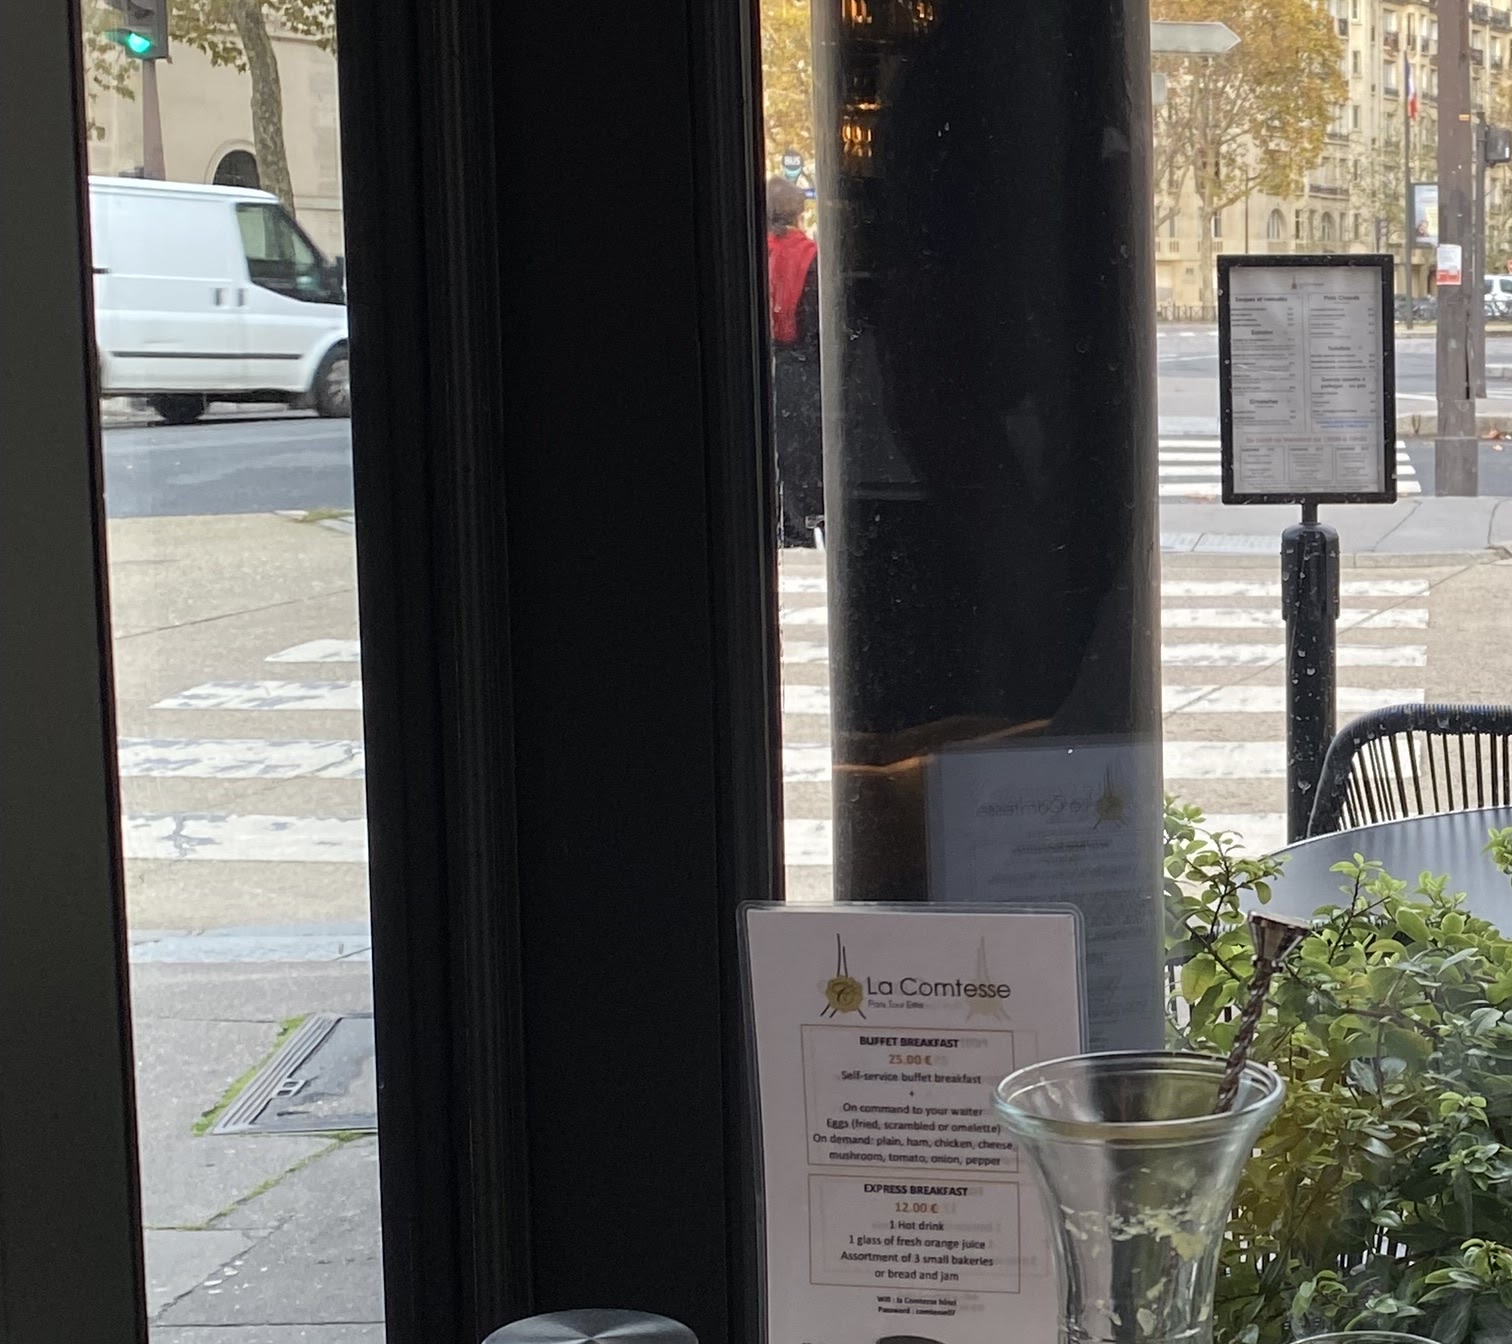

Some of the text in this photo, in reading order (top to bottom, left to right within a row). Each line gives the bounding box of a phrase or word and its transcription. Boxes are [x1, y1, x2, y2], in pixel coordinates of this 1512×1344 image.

[867, 977, 1011, 998] La Comtesse
[860, 1036, 959, 1048] BUFFET BREAKFAST
[889, 1054, 933, 1065] 25.00 €
[841, 1070, 981, 1084] Self-service buffet breakfast
[843, 1103, 983, 1117] On command to your waiter
[826, 1118, 1001, 1135] Eggs (fried, scrambled or omelette)
[813, 1133, 827, 1143] On
[876, 1136, 904, 1148] plain,
[907, 1138, 931, 1148] ham,
[934, 1139, 975, 1150] chicken,
[829, 1151, 1001, 1167] mushroom, tomato, onion, pepper
[864, 1184, 969, 1196] EXPRESS BREAKFAST
[895, 1202, 939, 1214] 12.00 €
[898, 1221, 915, 1231] Hot
[918, 1221, 944, 1232] drink
[857, 1235, 882, 1247] glass
[884, 1235, 895, 1246] of
[896, 1236, 922, 1247] fresh
[924, 1240, 959, 1250] orange
[962, 1239, 985, 1251] juice
[841, 1251, 898, 1263] Assortment
[901, 1252, 912, 1263] of
[922, 1255, 949, 1265] small
[952, 1255, 994, 1267] bakeries
[874, 1269, 959, 1282] or bread and jam
